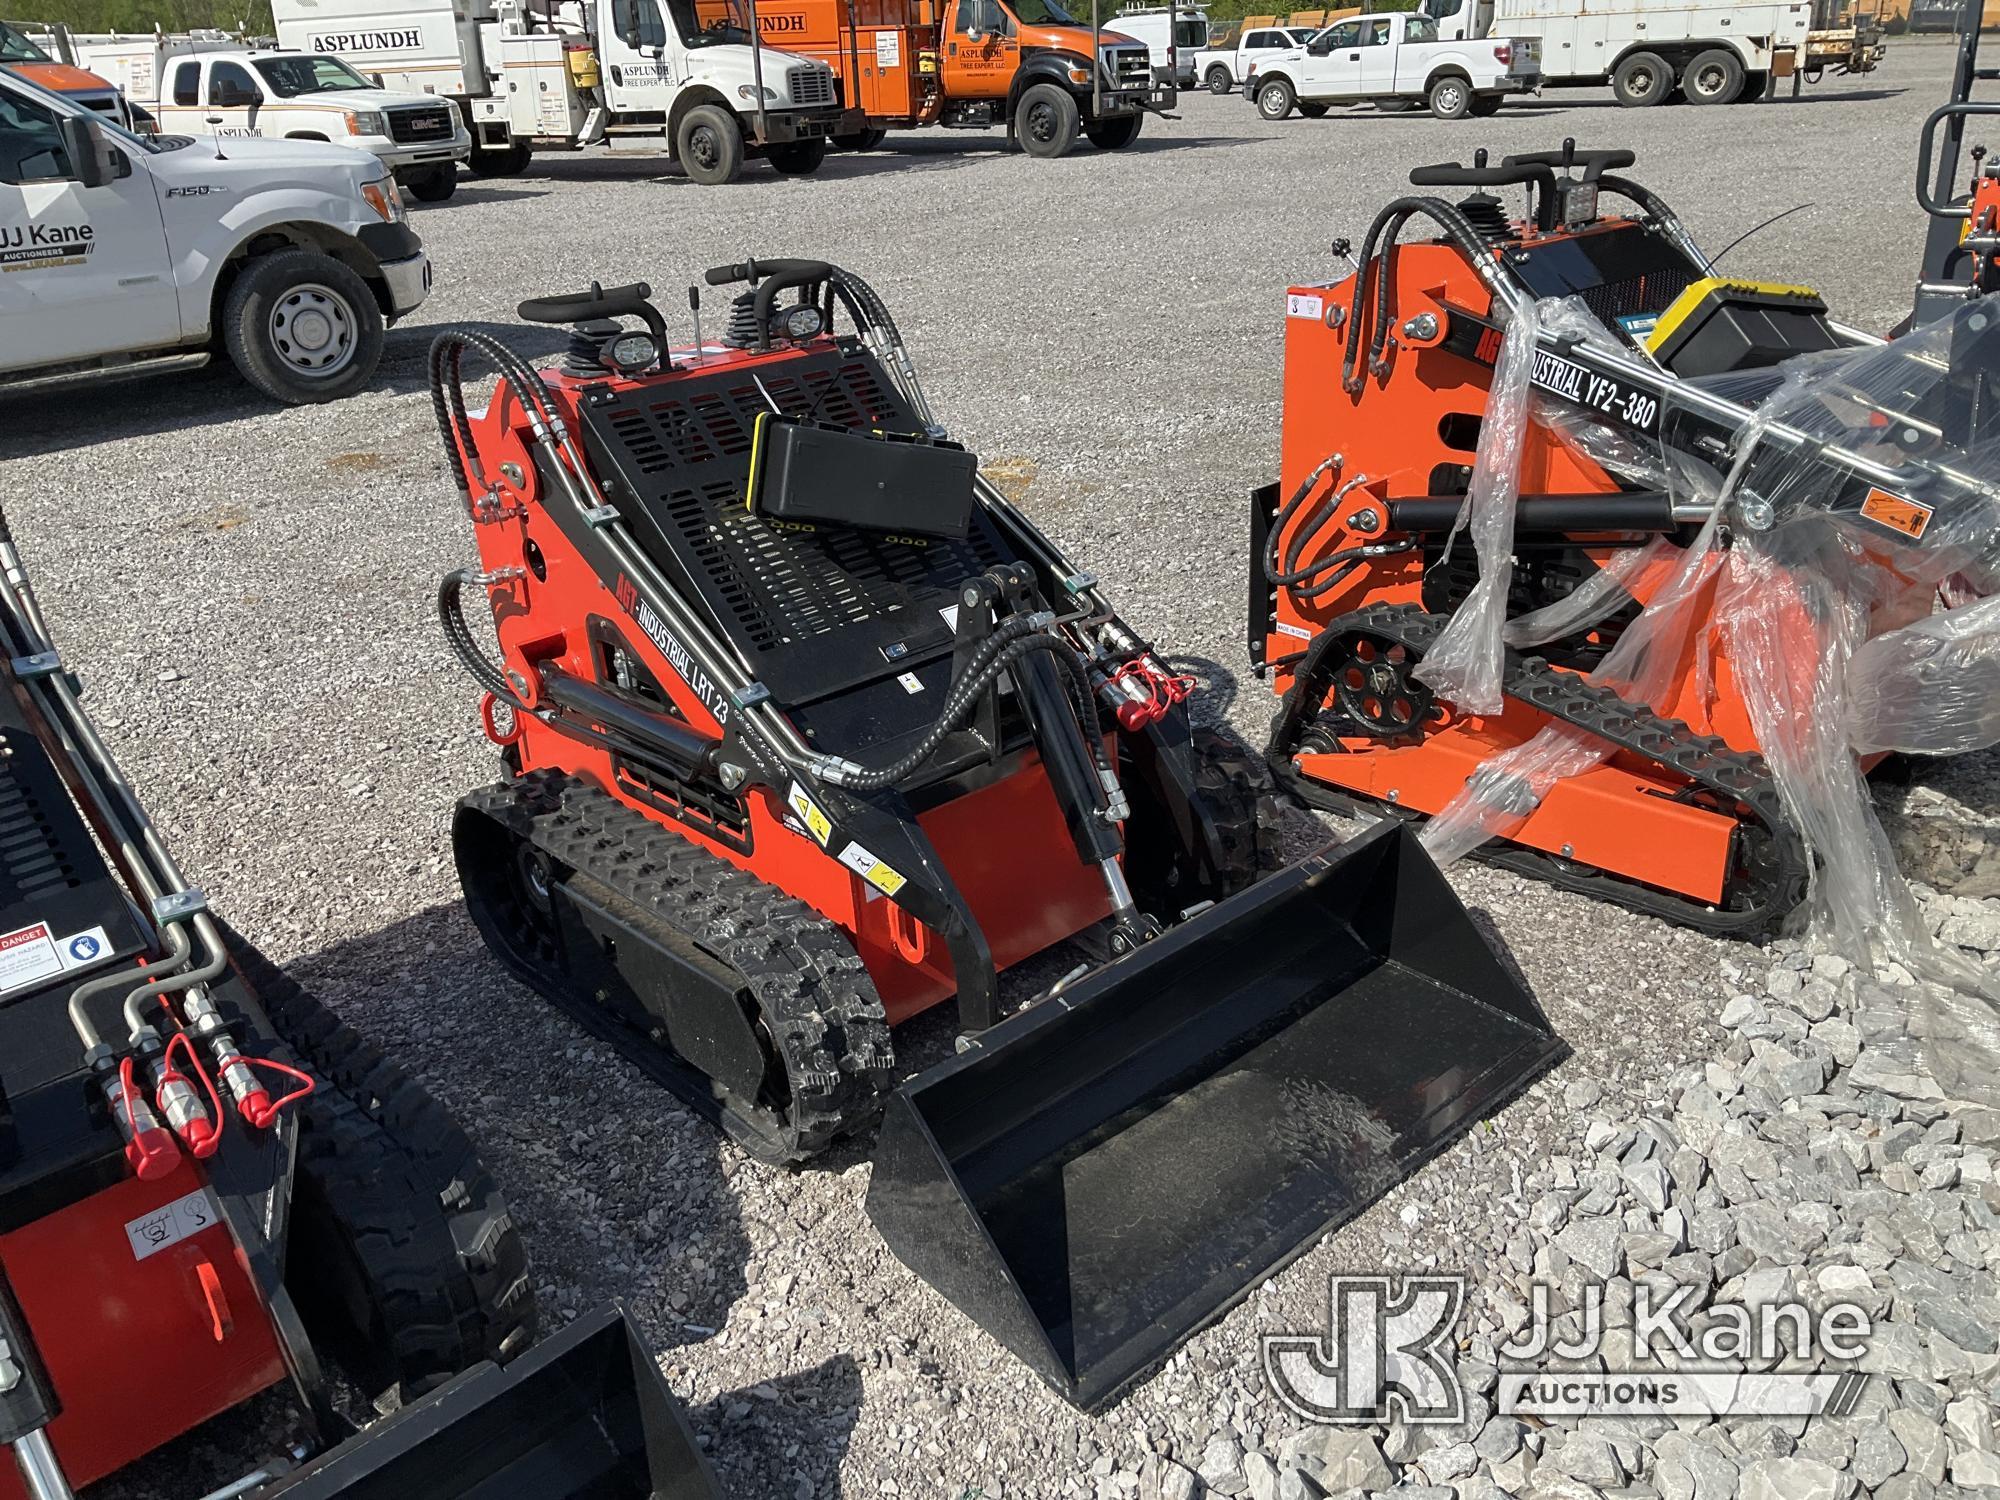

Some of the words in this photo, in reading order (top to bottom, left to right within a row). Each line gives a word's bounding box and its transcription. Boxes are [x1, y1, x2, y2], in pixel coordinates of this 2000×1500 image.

[314, 30, 421, 52] ASPLUNDH
[624, 65, 669, 76] ASPLUNDH
[412, 118, 440, 129] GMC
[0, 226, 23, 248] JJ
[29, 224, 93, 245] Kane
[4, 248, 64, 260] AUCTIONEERS
[1474, 326, 1503, 364] AG
[1531, 352, 1583, 397] USTRIAL
[1585, 374, 1657, 428] YF2-380
[692, 666, 715, 706] LRT
[713, 693, 729, 724] 23
